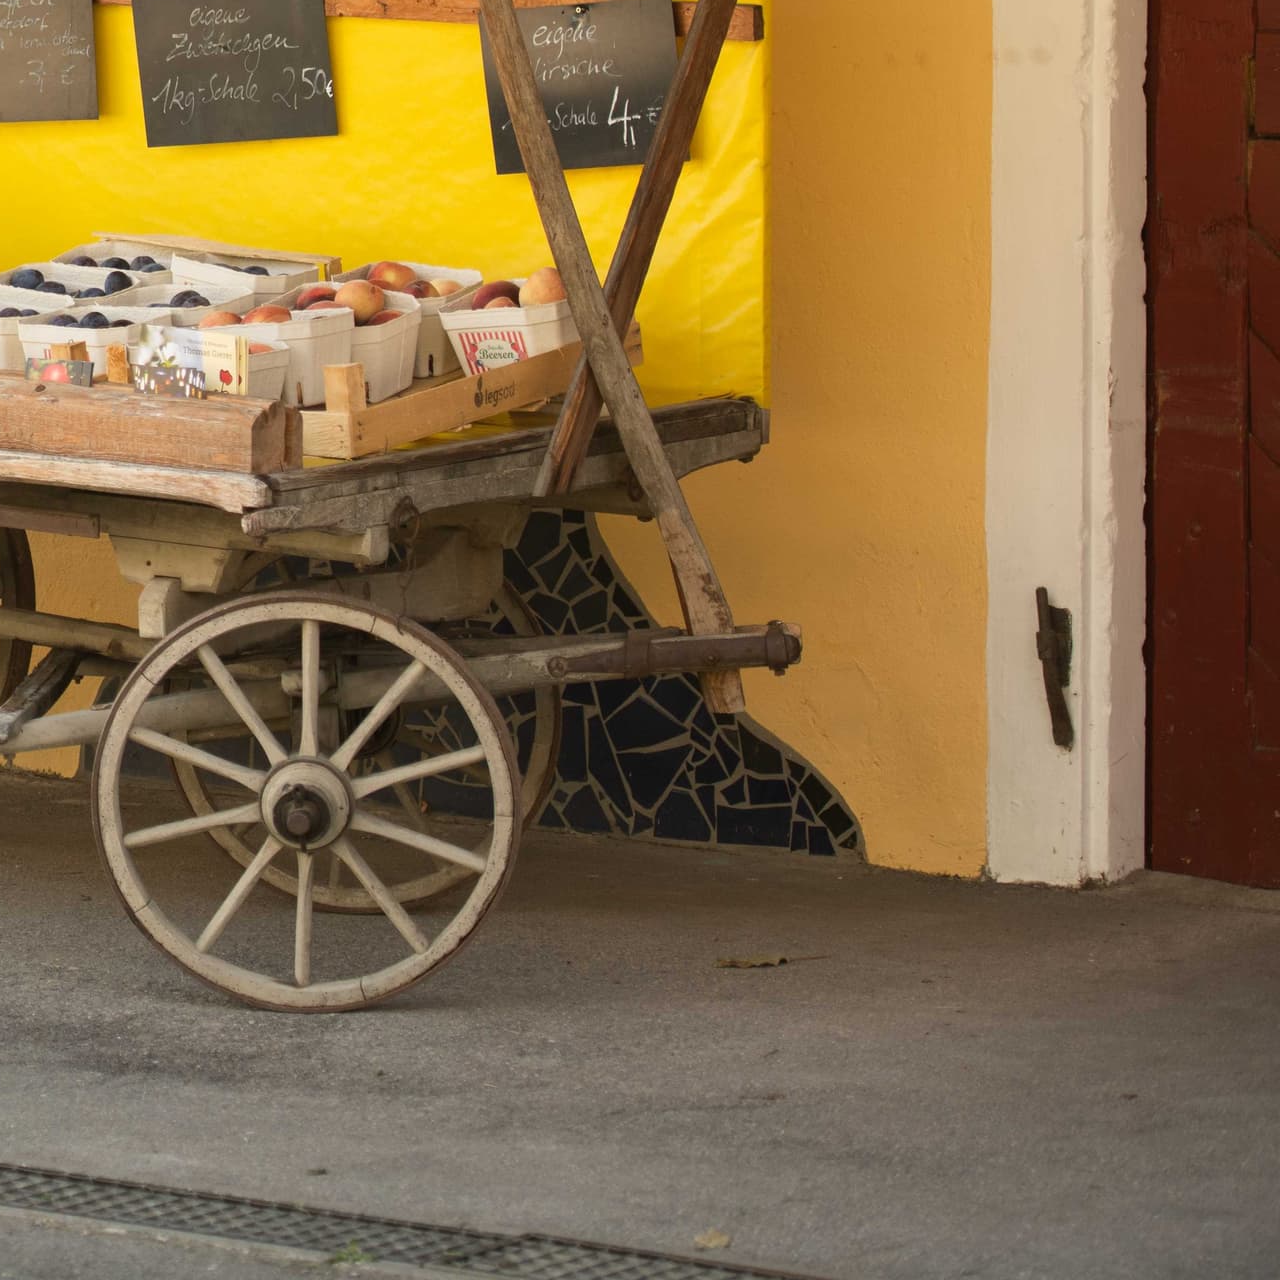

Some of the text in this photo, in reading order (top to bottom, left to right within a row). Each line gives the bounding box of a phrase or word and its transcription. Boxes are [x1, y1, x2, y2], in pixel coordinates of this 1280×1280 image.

[190, 4, 251, 41] eigene
[532, 20, 599, 59] eigene
[165, 32, 300, 73] Zwetschgen
[533, 57, 624, 81] firsiche
[272, 66, 334, 110] 2,50€
[479, 348, 515, 360] Beeren
